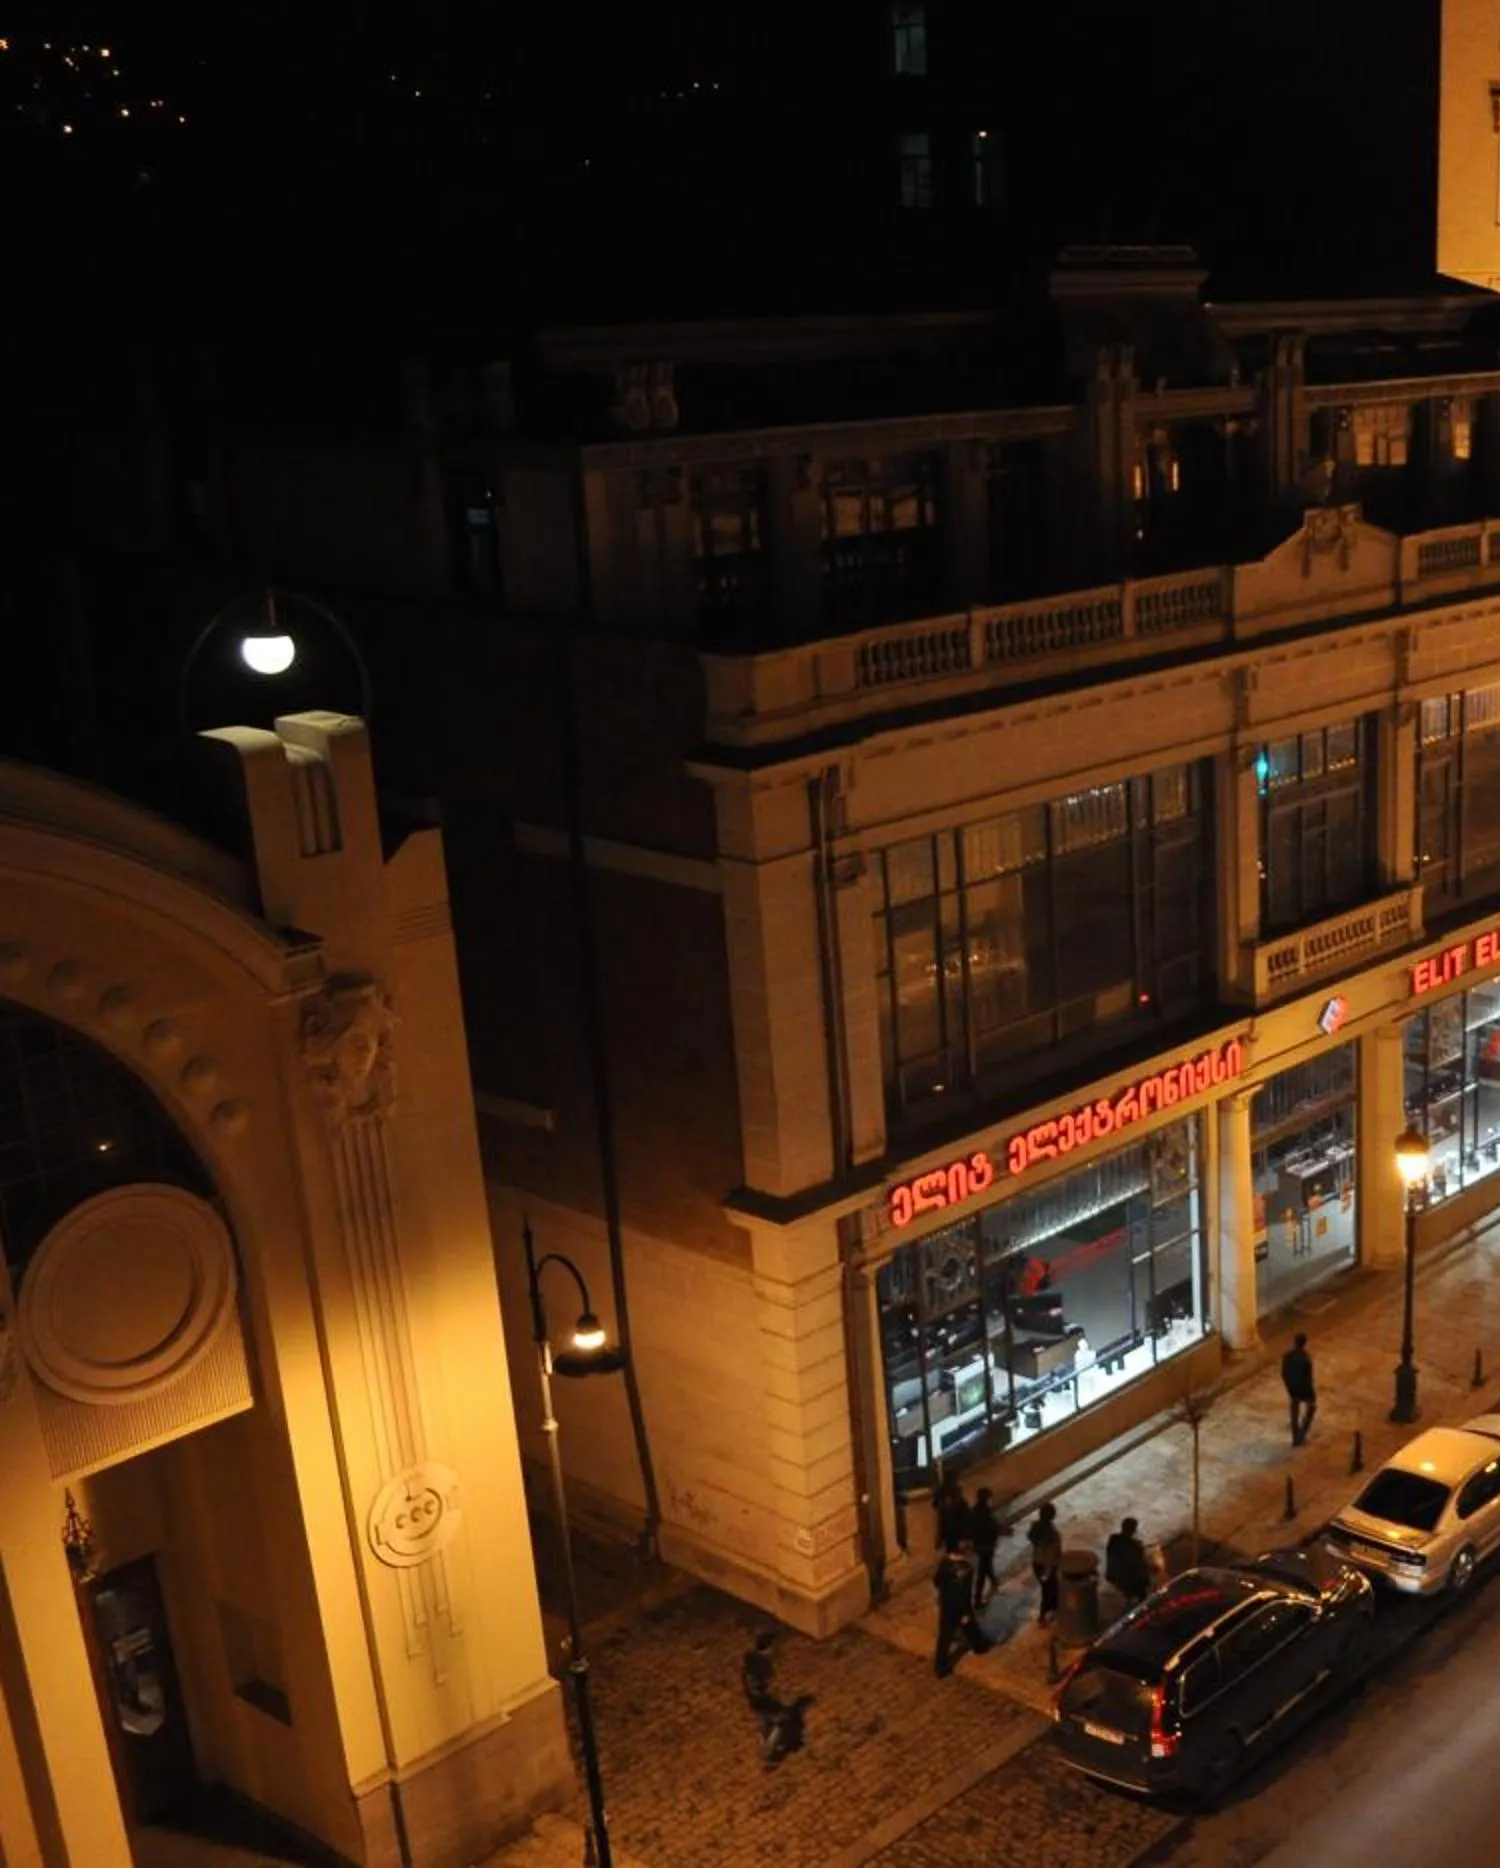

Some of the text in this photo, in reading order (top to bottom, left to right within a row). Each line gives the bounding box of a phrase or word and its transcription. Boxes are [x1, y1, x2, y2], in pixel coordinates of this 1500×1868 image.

[1413, 944, 1467, 994] ELIT
[891, 1040, 1244, 1227] ელიტ ელექტრონიქსი
